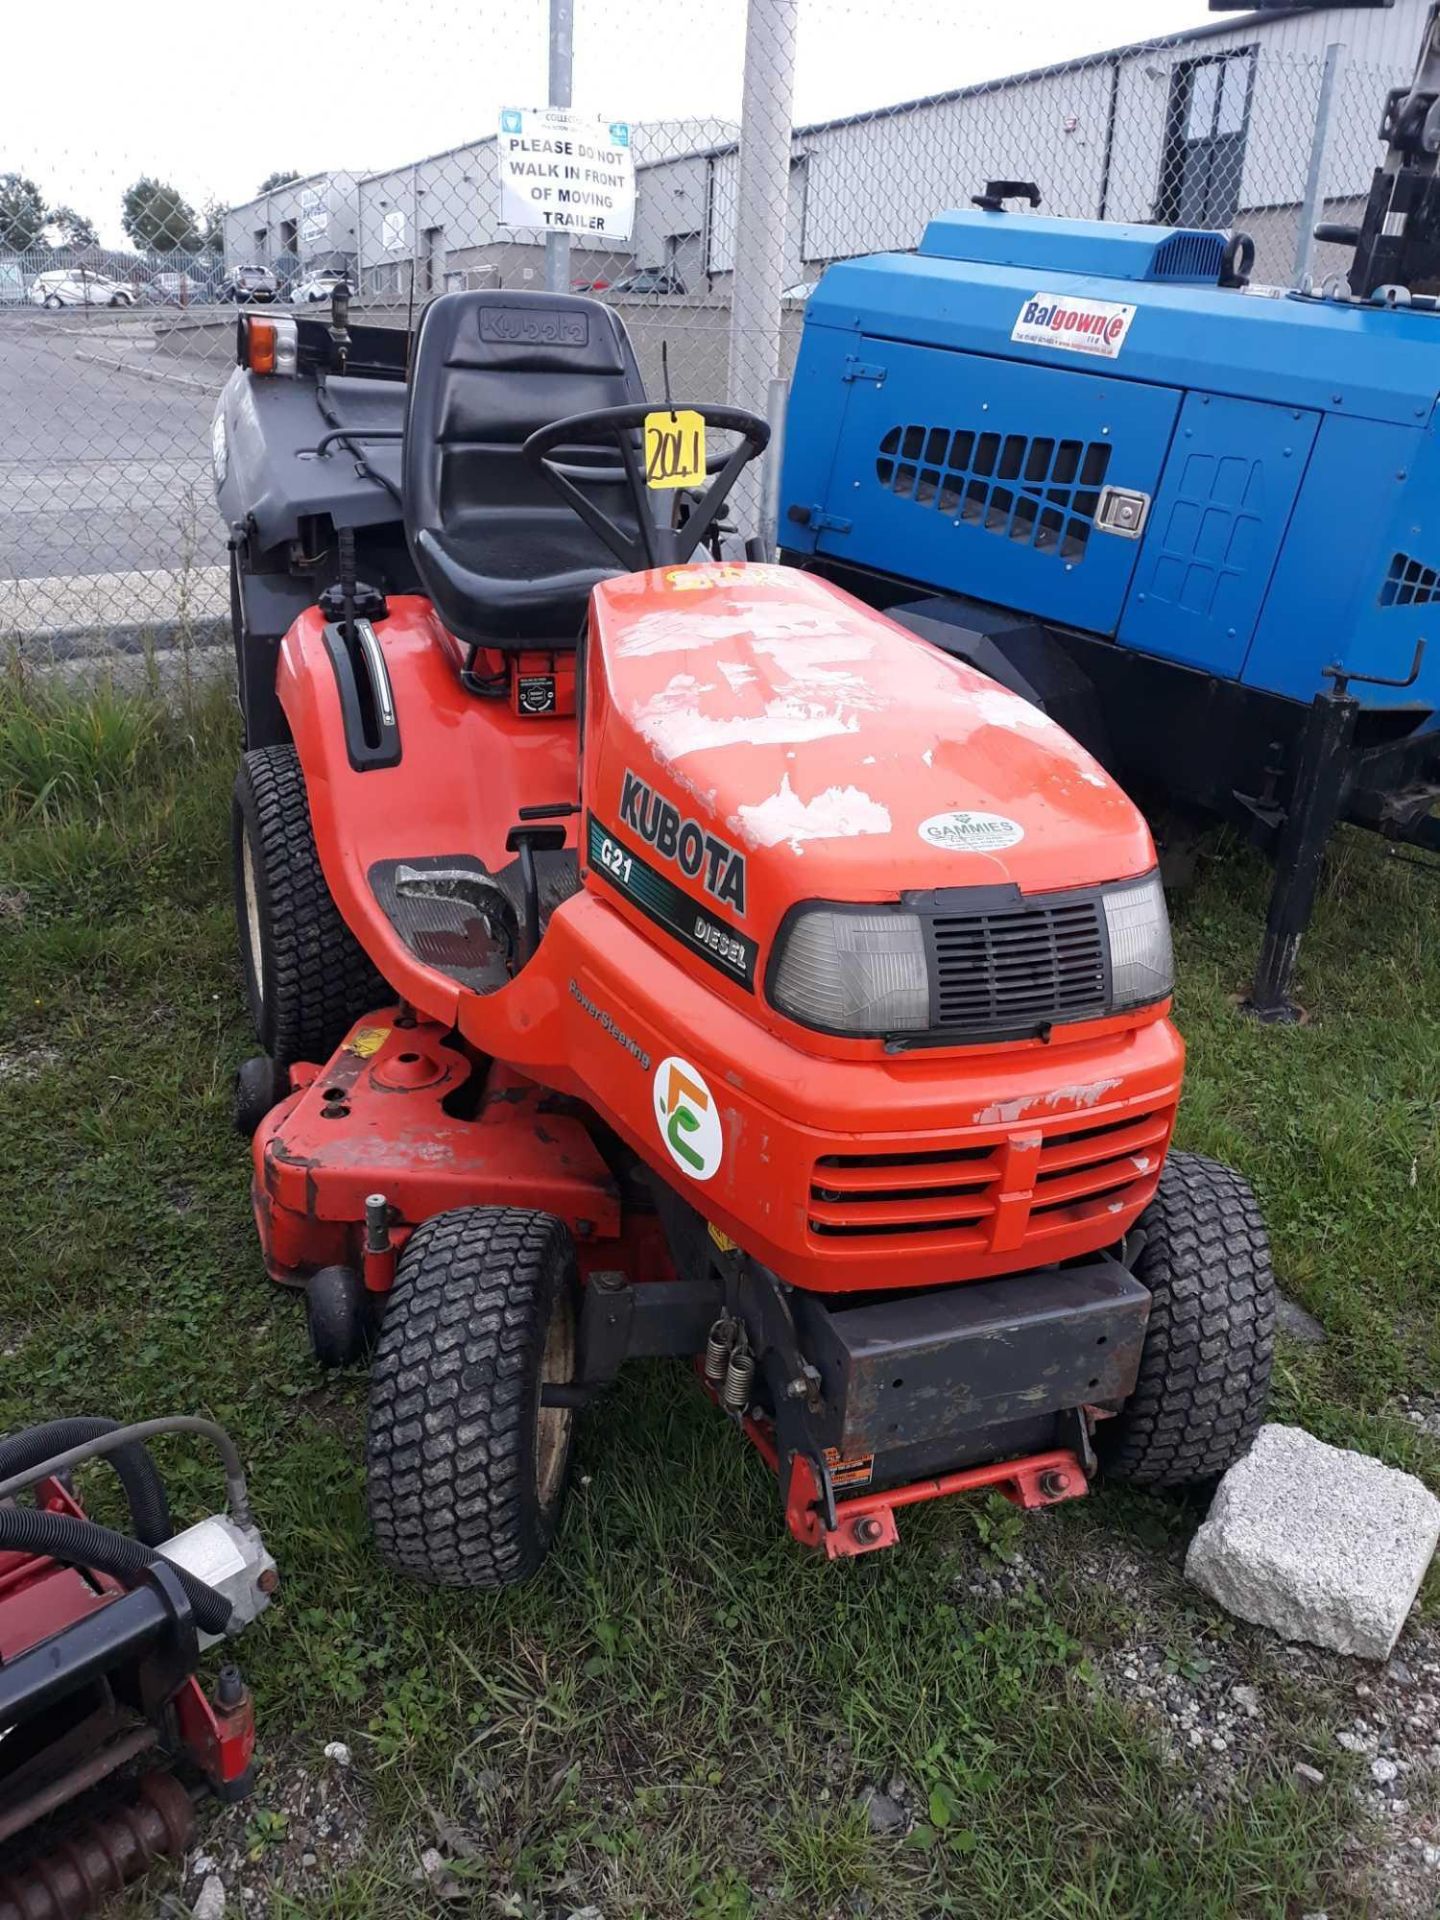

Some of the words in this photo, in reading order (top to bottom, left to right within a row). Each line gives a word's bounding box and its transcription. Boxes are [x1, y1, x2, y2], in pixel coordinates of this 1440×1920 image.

[510, 139, 573, 155] PLEASE
[578, 144, 594, 159] DO
[598, 150, 624, 165] NOT
[510, 161, 560, 178] WALK
[565, 166, 580, 180] IN
[585, 169, 625, 188] FRONT
[531, 187, 552, 200] OF
[558, 189, 613, 208] MOVING
[543, 211, 605, 230] TRAILER
[484, 312, 587, 342] Kubota
[619, 767, 747, 919] KUBOTA
[927, 822, 1014, 838] GAMMIES
[600, 839, 633, 884] G21
[694, 916, 747, 970] DIESEL
